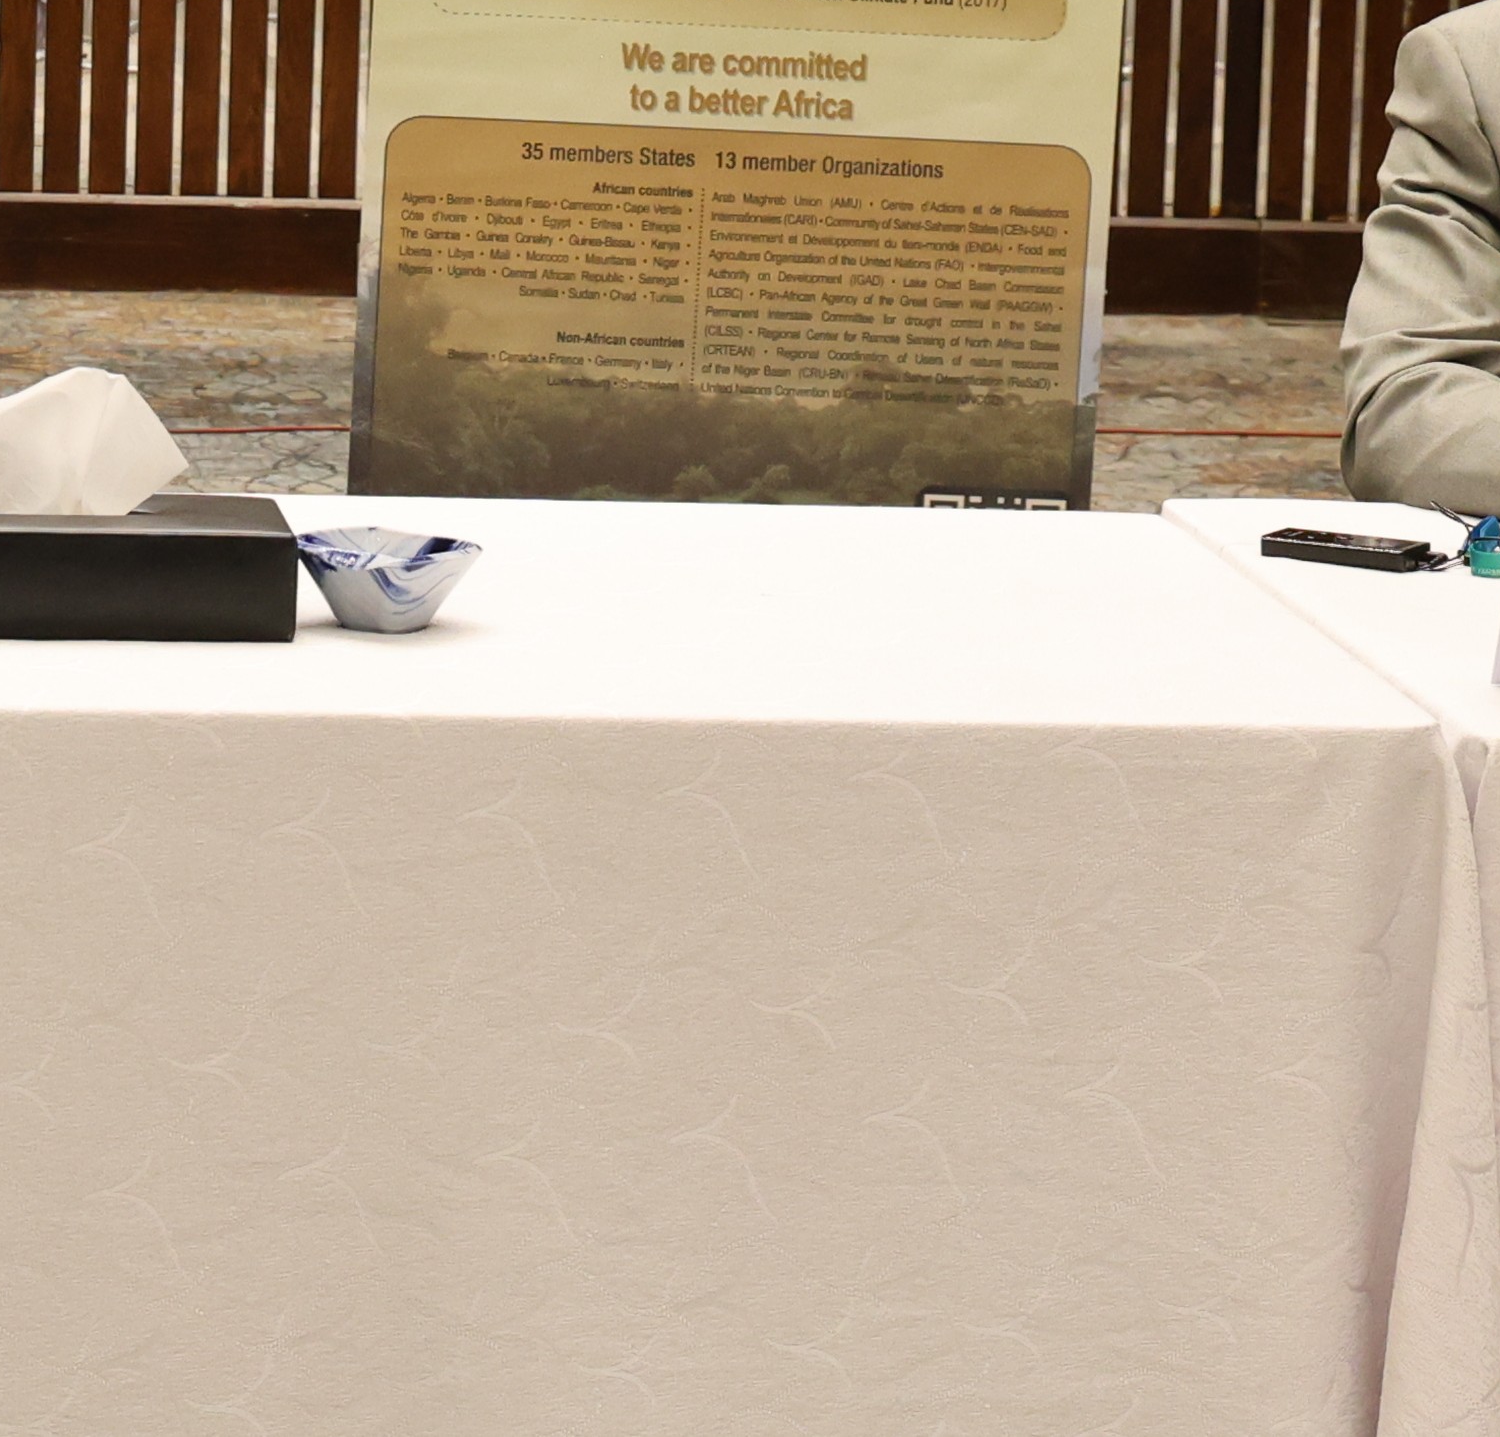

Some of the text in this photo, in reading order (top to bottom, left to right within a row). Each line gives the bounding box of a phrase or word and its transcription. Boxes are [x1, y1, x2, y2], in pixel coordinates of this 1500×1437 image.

[622, 43, 868, 82] We are committed
[630, 84, 853, 121] to a better Africa
[522, 142, 943, 179] 35 members States 13 member Organizations
